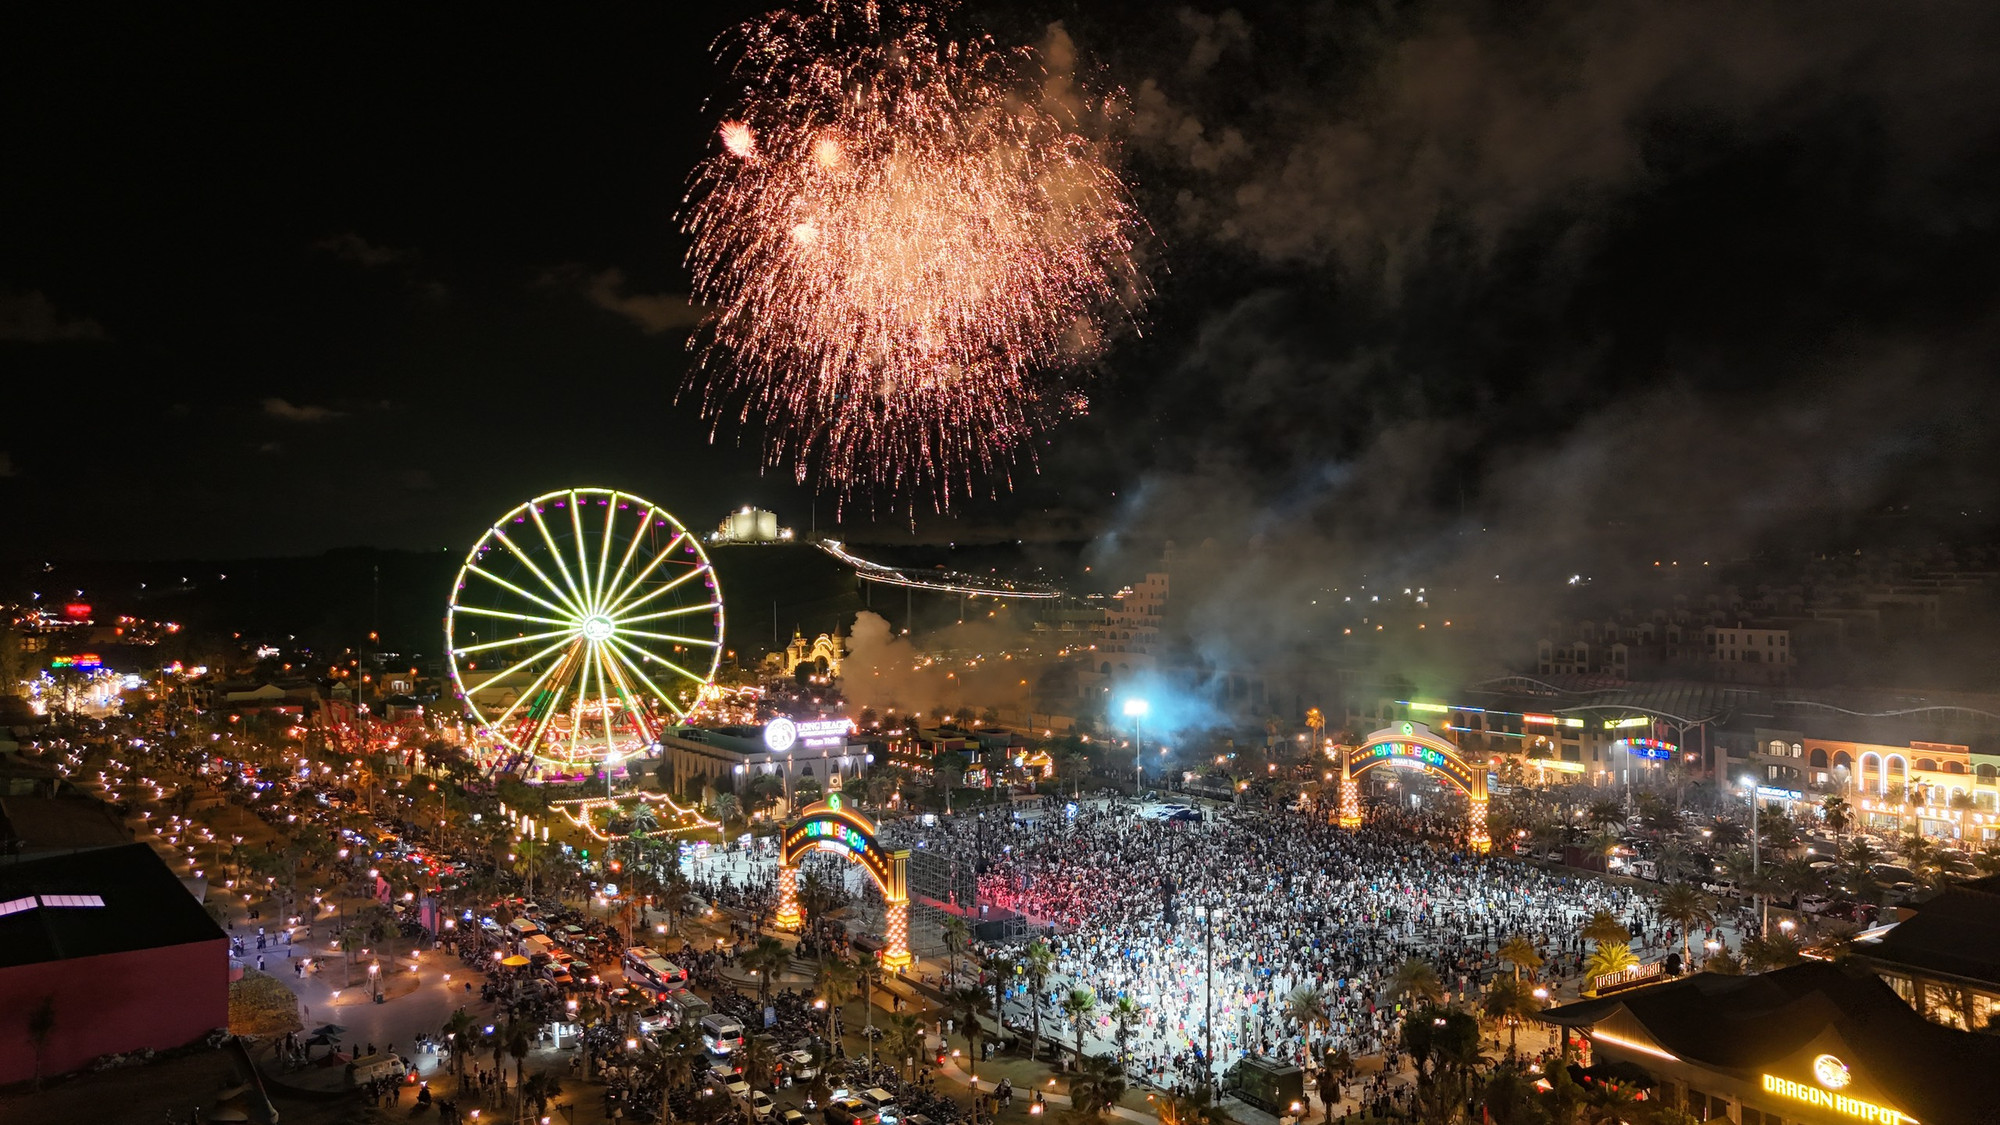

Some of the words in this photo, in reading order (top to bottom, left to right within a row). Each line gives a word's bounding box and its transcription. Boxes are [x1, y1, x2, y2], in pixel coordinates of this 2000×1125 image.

[797, 722, 820, 732] LONG
[1375, 743, 1405, 756] BIKINI
[1407, 745, 1444, 766] BEACH
[1635, 738, 1653, 746] NIGHT
[1653, 740, 1678, 752] MARKET
[807, 821, 833, 837] BIKINI
[834, 823, 865, 852] BEACH
[1763, 1073, 1834, 1109] DRAGON
[1835, 1093, 1901, 1125] HOTPOT
